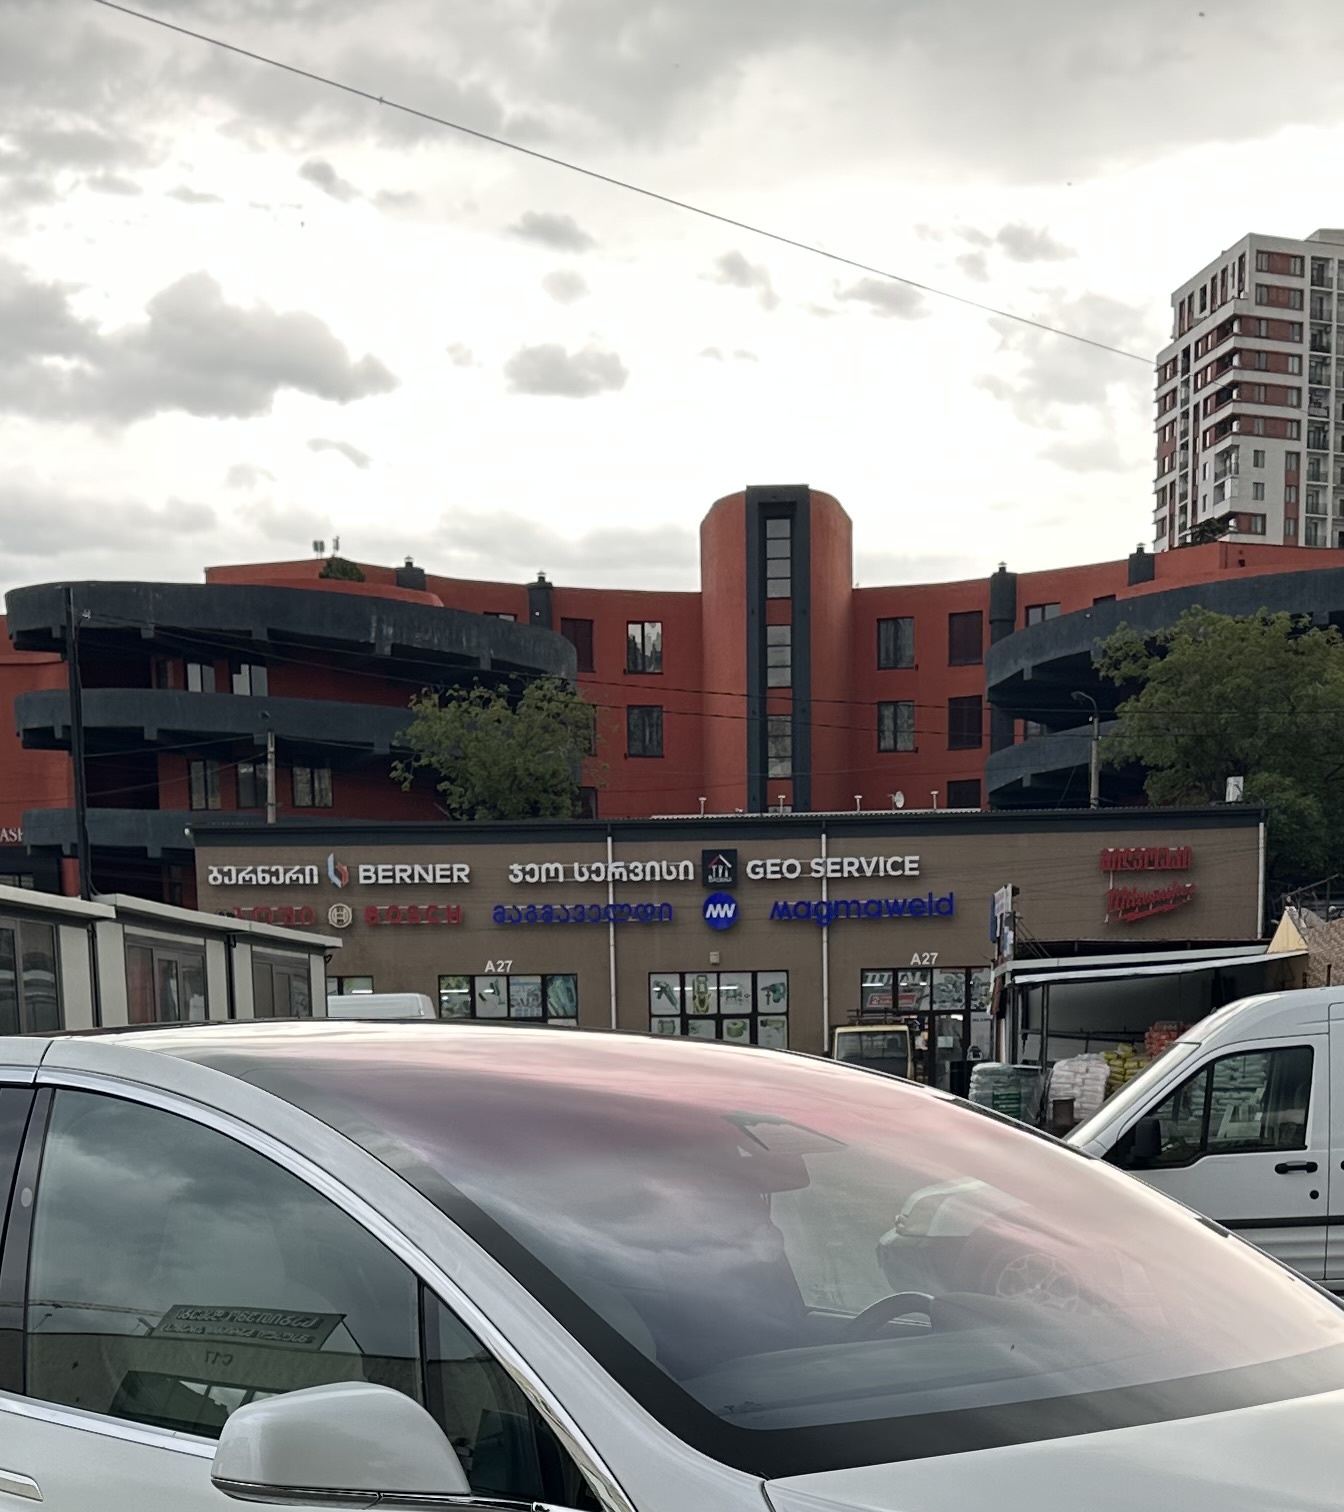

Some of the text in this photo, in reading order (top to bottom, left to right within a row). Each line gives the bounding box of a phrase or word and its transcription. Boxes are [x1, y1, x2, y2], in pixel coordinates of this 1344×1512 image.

[208, 865, 319, 885] ბერნერი
[358, 863, 470, 885] BERNER
[508, 860, 695, 884] ჯეო სერვისი
[746, 855, 920, 880] GEO SERVICE
[364, 904, 462, 926] BOSCH
[492, 902, 673, 925] მაგმაველდი
[484, 960, 513, 973] A27
[910, 952, 939, 966] A27
